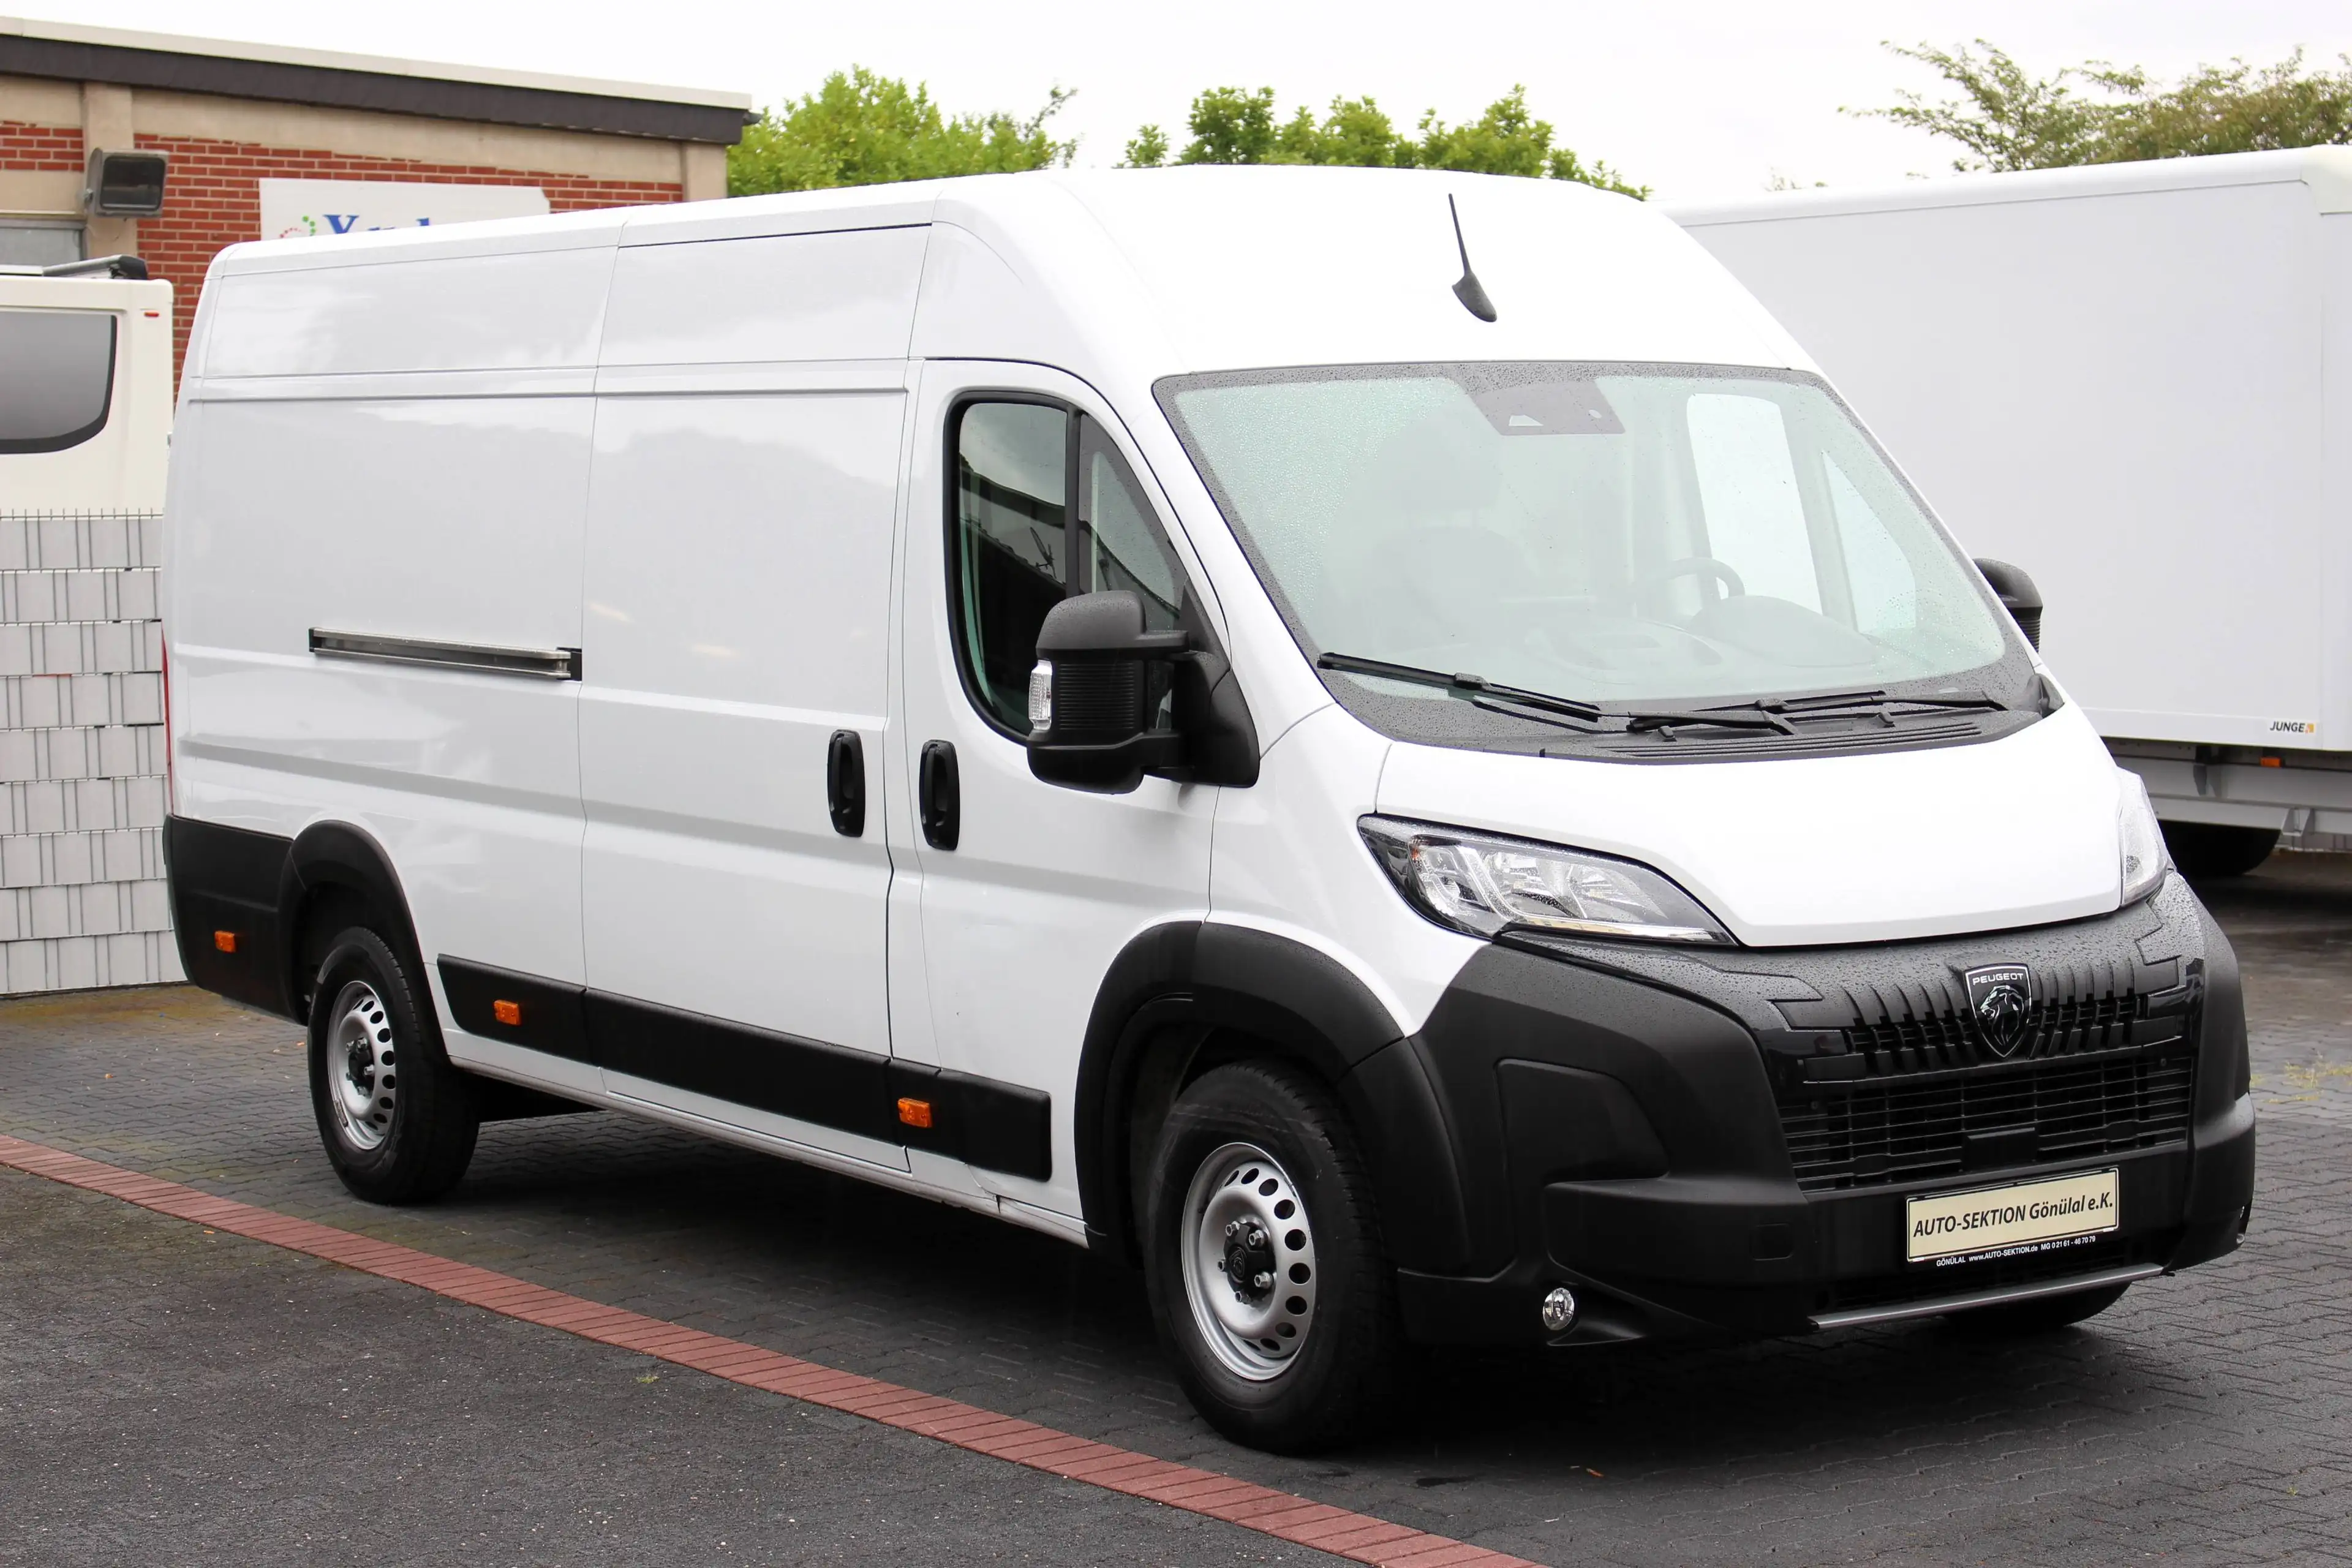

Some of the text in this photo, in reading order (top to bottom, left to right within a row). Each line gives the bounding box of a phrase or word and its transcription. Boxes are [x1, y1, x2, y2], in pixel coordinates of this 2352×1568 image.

[2270, 721, 2305, 733] JUNGE
[1972, 973, 2024, 986] PEUGEOT
[1913, 1191, 2113, 1237] AUTO-SEKTION Gönülal e.K.
[1936, 1256, 1966, 1267] GÖNÜLAL
[1969, 1245, 2038, 1262] www.AUTO-SEKTION.de
